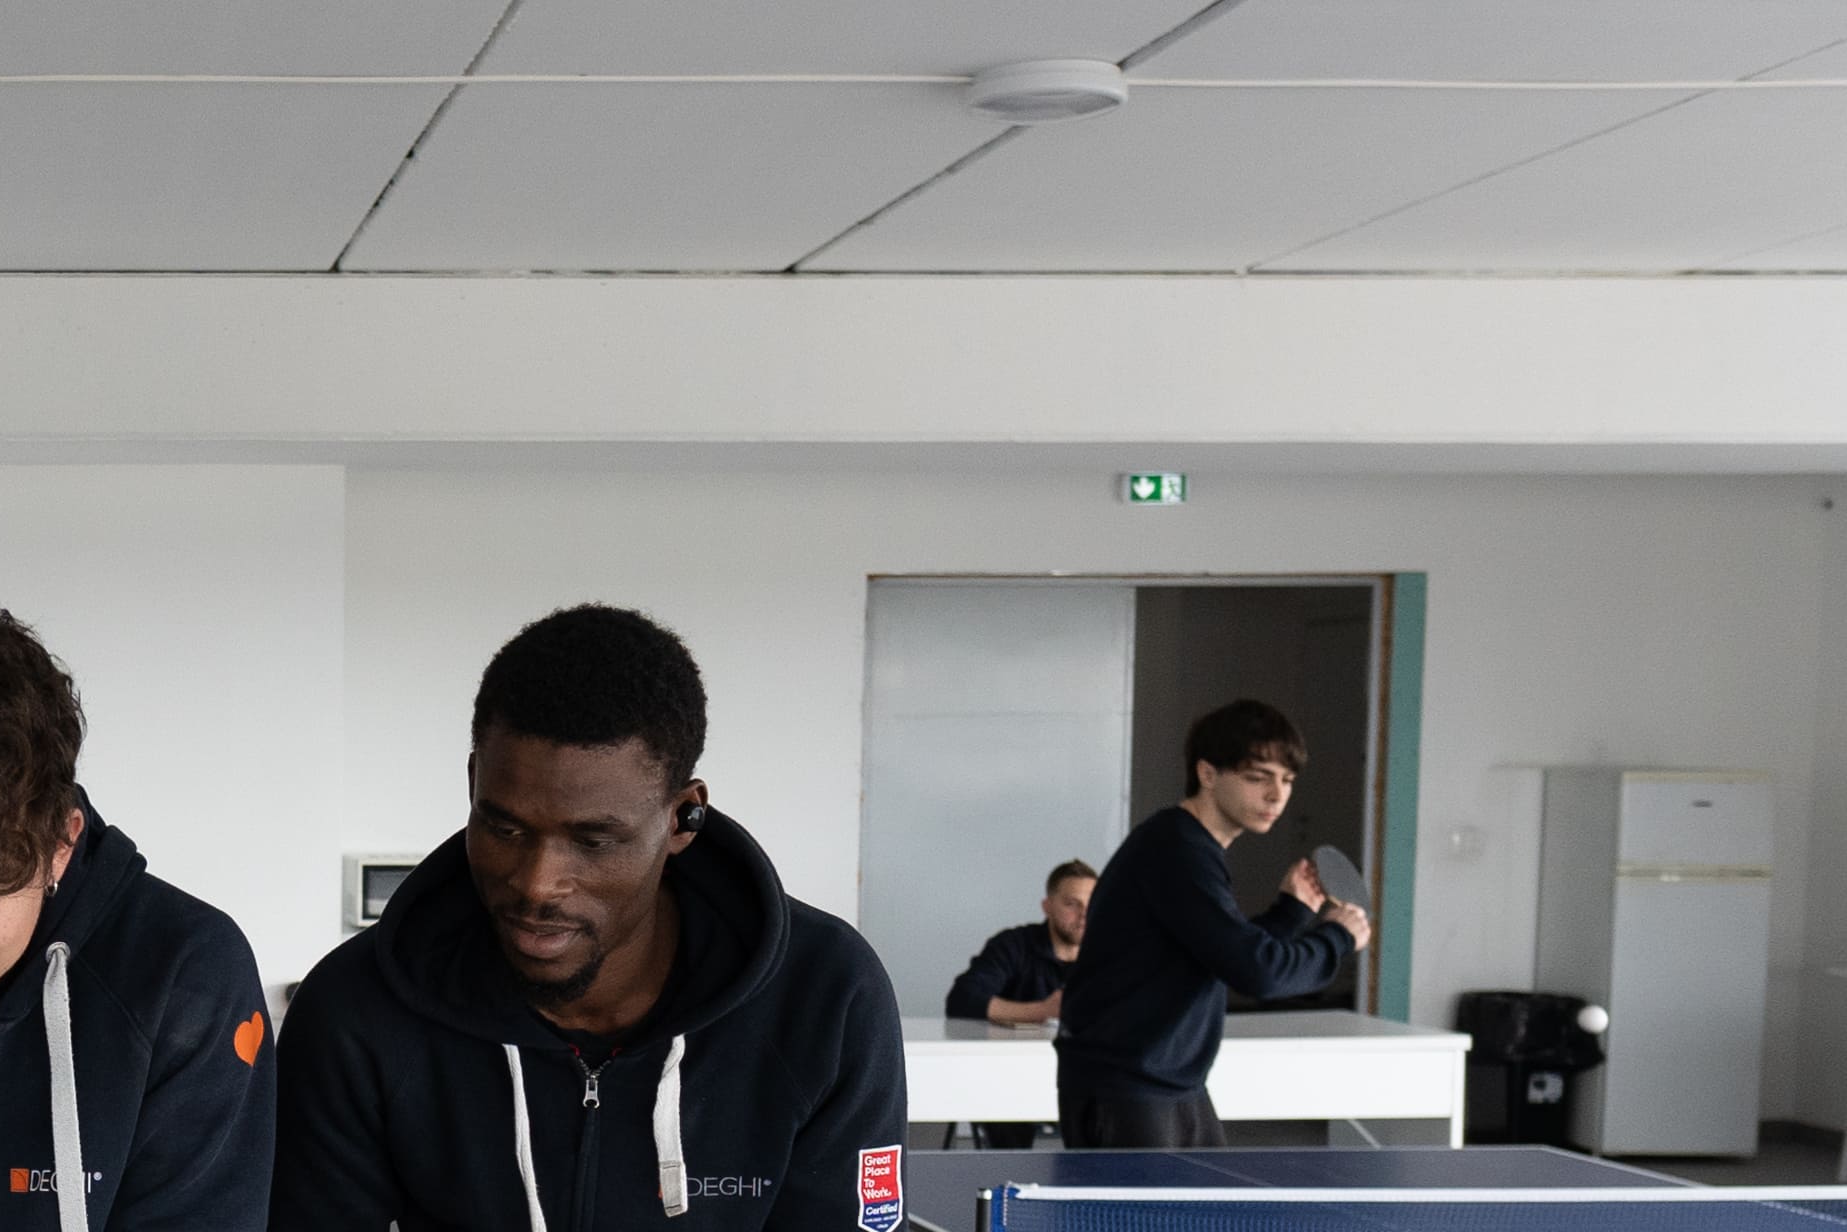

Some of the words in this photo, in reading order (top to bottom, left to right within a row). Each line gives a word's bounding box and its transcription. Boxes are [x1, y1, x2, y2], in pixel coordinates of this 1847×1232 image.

[864, 1154, 891, 1166] Great
[865, 1166, 890, 1177] Place
[687, 1176, 762, 1198] DEGHI
[864, 1178, 875, 1188] To
[865, 1202, 898, 1216] Certified
